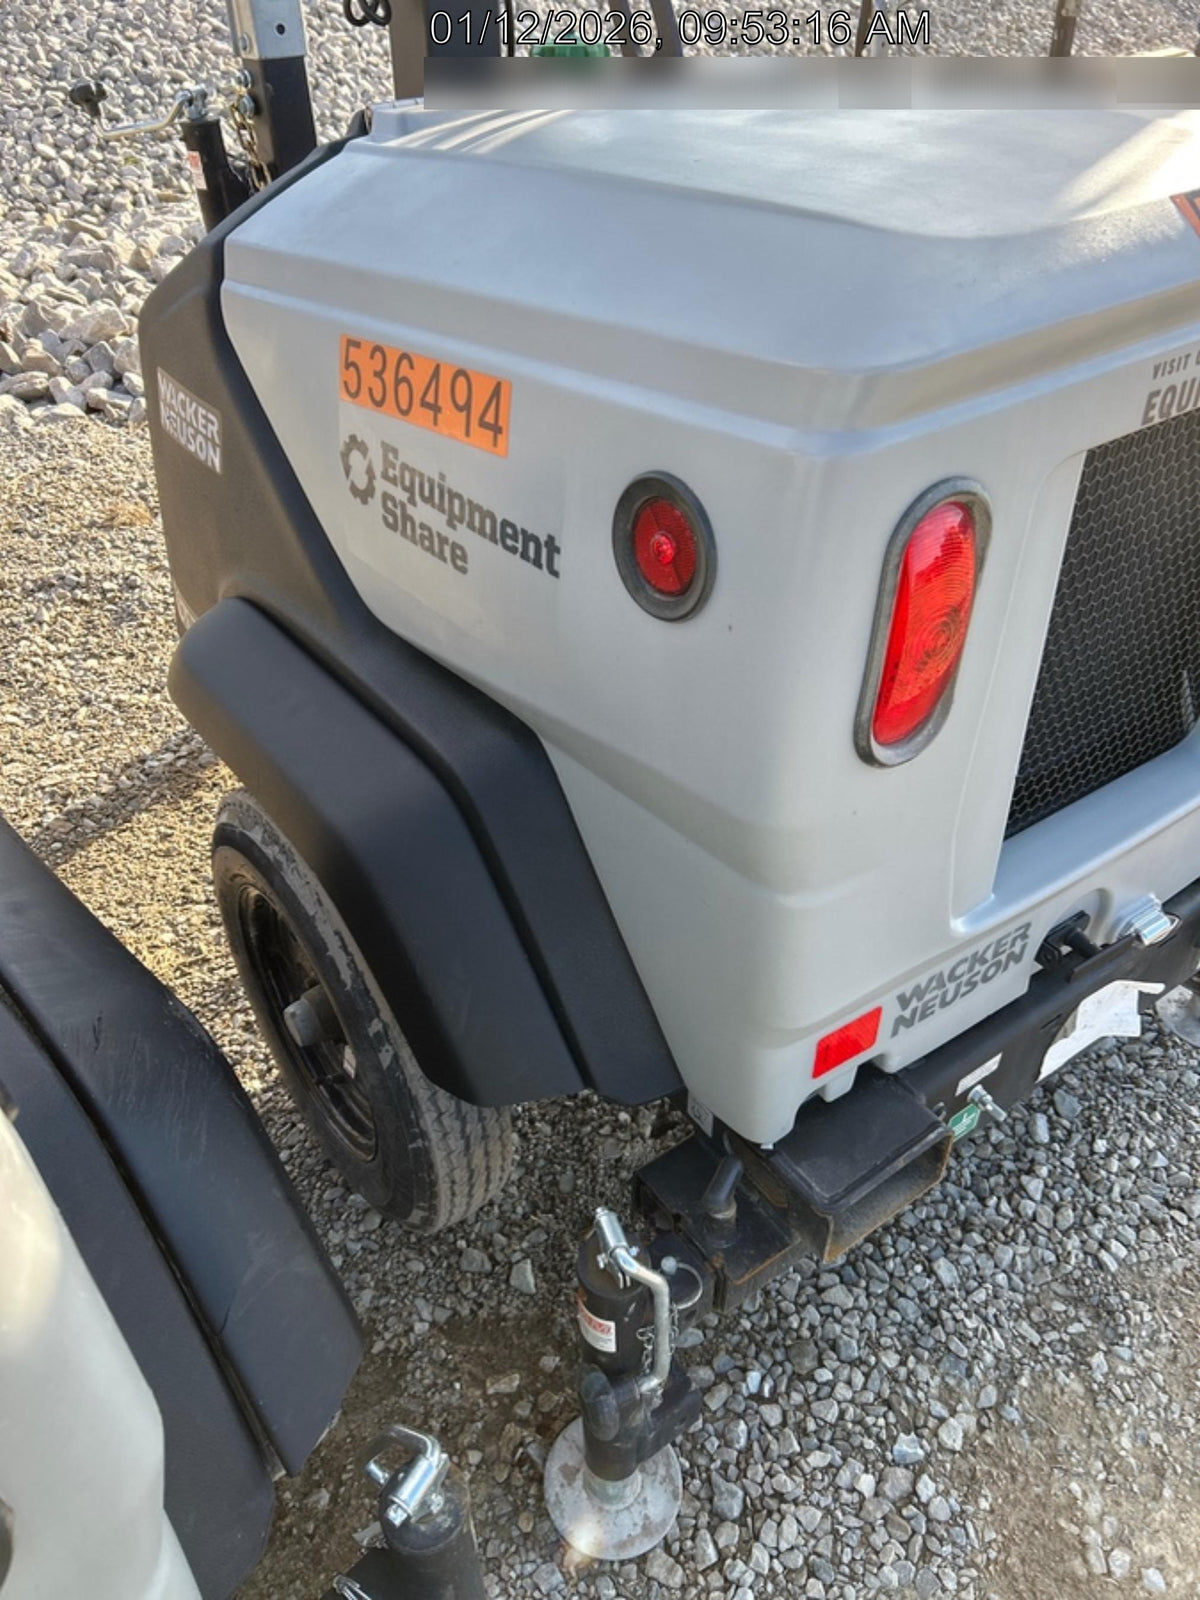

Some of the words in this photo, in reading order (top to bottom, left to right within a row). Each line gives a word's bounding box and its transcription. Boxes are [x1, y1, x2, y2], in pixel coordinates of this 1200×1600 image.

[157, 370, 221, 445] WACKER
[343, 338, 504, 449] 536494
[1152, 353, 1192, 380] VISIT
[160, 401, 221, 474] NEUSON
[380, 440, 561, 579] Equipment
[381, 490, 469, 576] Share
[891, 943, 1028, 1039] NEUSON
[896, 922, 1033, 1012] WACKER
